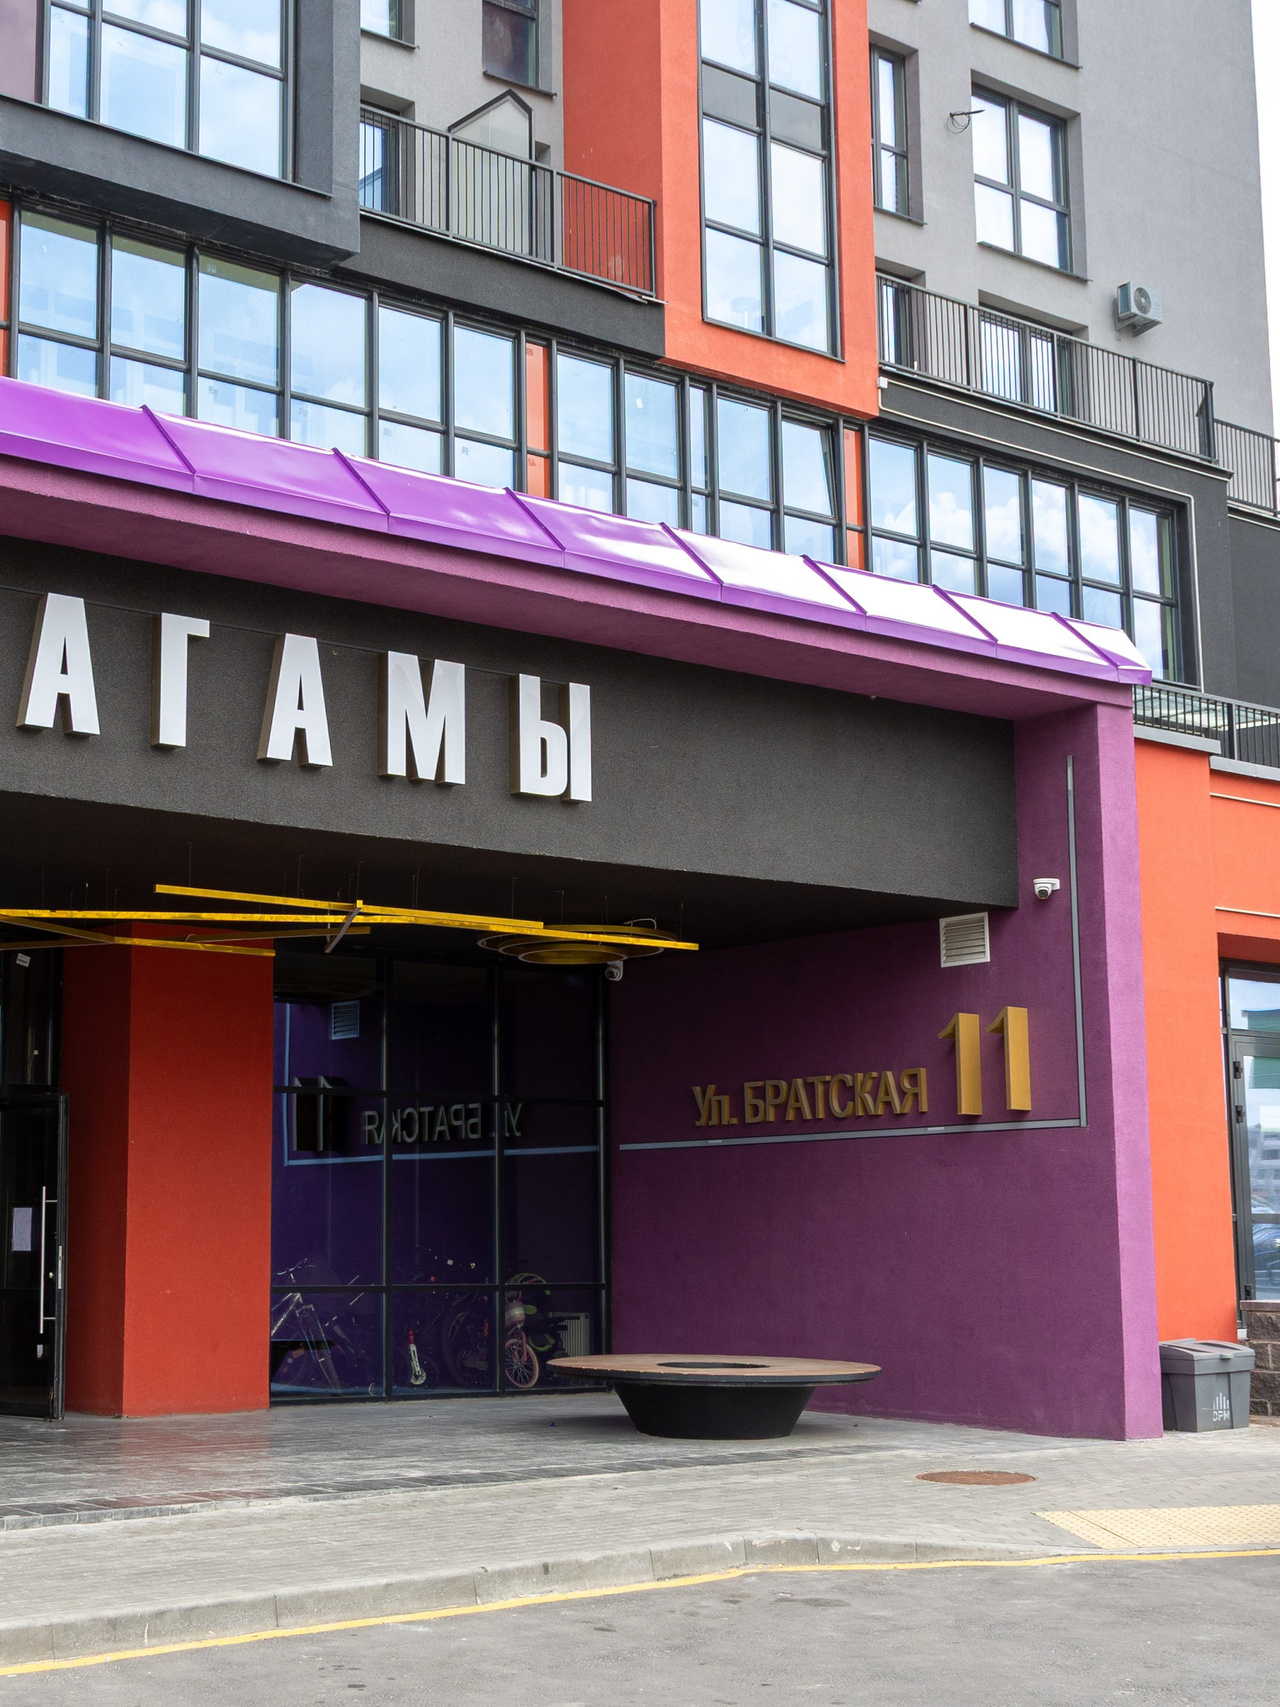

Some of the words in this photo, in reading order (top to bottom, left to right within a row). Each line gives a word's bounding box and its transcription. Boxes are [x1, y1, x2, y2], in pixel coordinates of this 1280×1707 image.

[692, 1085, 738, 1127] Ул.
[743, 1067, 929, 1125] БРАТСКАЯ
[938, 1006, 1032, 1116] 11
[1212, 1410, 1231, 1422] DPM
